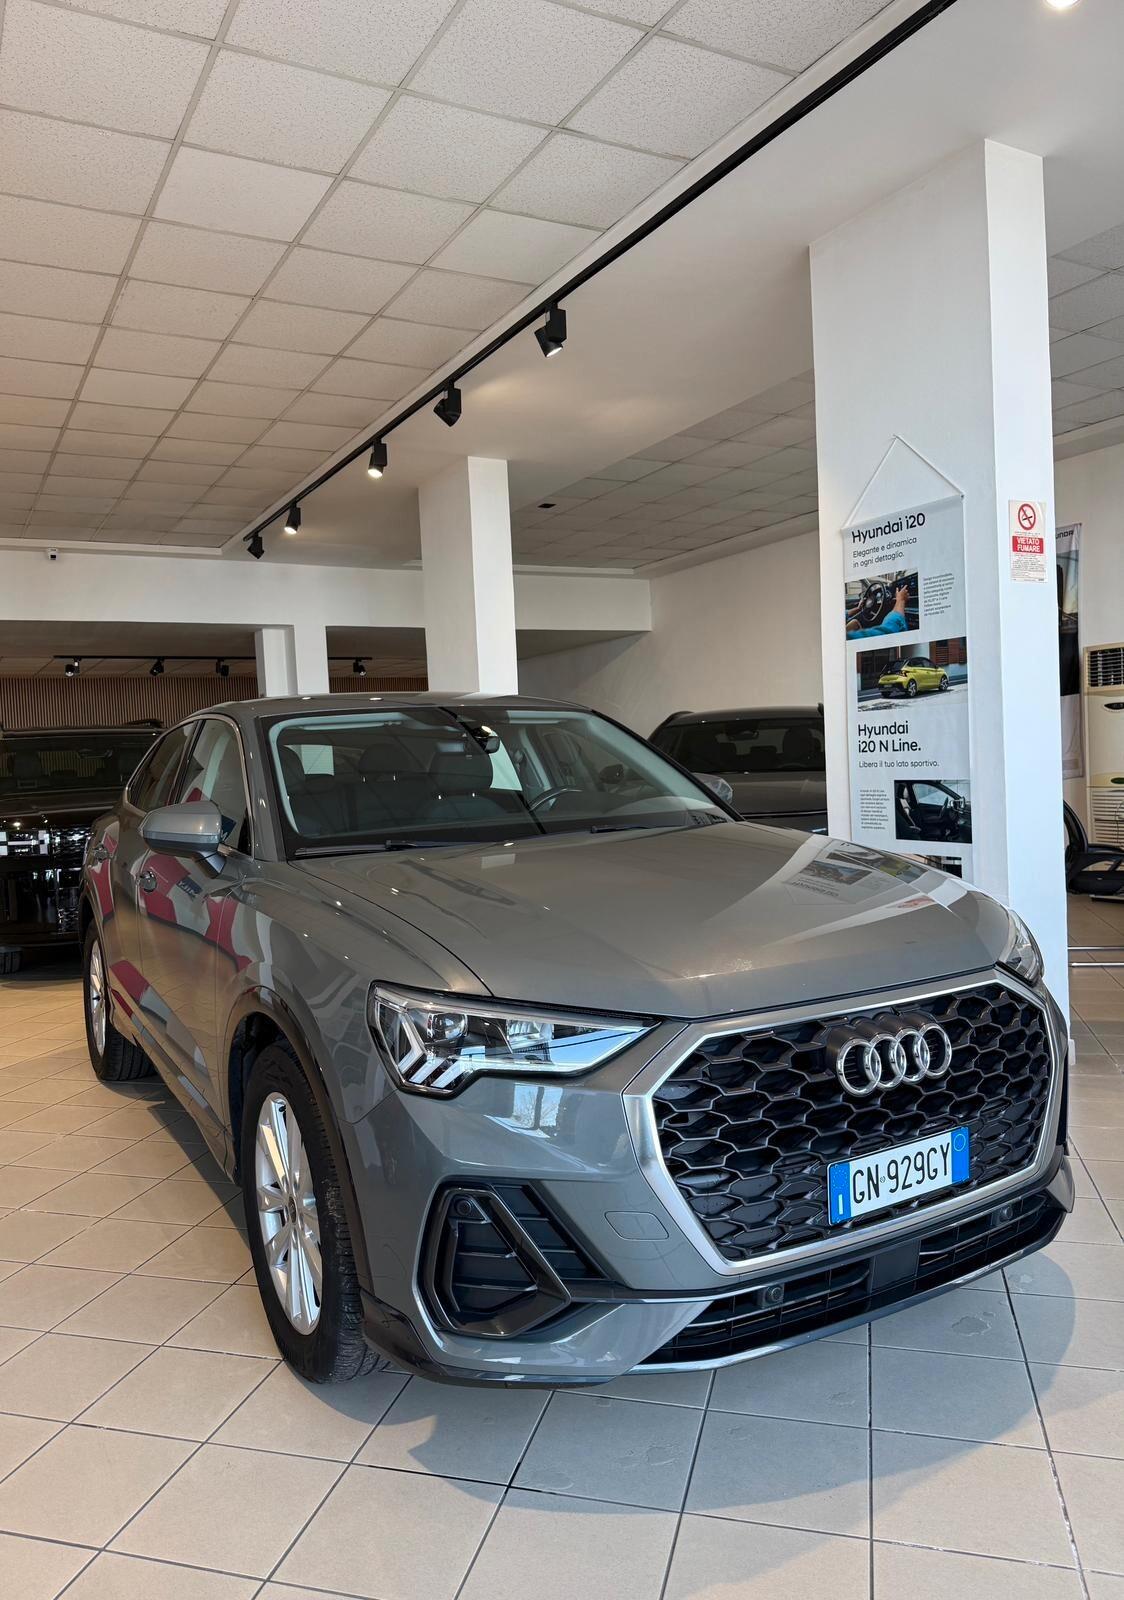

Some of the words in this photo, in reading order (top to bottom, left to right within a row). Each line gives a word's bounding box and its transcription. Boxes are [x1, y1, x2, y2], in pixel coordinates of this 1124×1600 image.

[851, 517, 903, 544] Hyundai
[905, 512, 926, 529] i20
[852, 546, 879, 558] Elegante
[886, 537, 917, 550] dinamica
[1017, 537, 1040, 545] VIETATO
[1017, 543, 1041, 552] FUMARE
[860, 556, 873, 567] ogni
[874, 550, 904, 563] dettaglio.
[857, 720, 908, 739] Hyundai
[858, 740, 876, 753] i20
[879, 739, 889, 752] N
[892, 738, 921, 752] Line.
[858, 760, 878, 768] Libera
[910, 759, 940, 768] sportivo.
[852, 1164, 880, 1204] GN
[887, 1142, 951, 1194] 929GY
